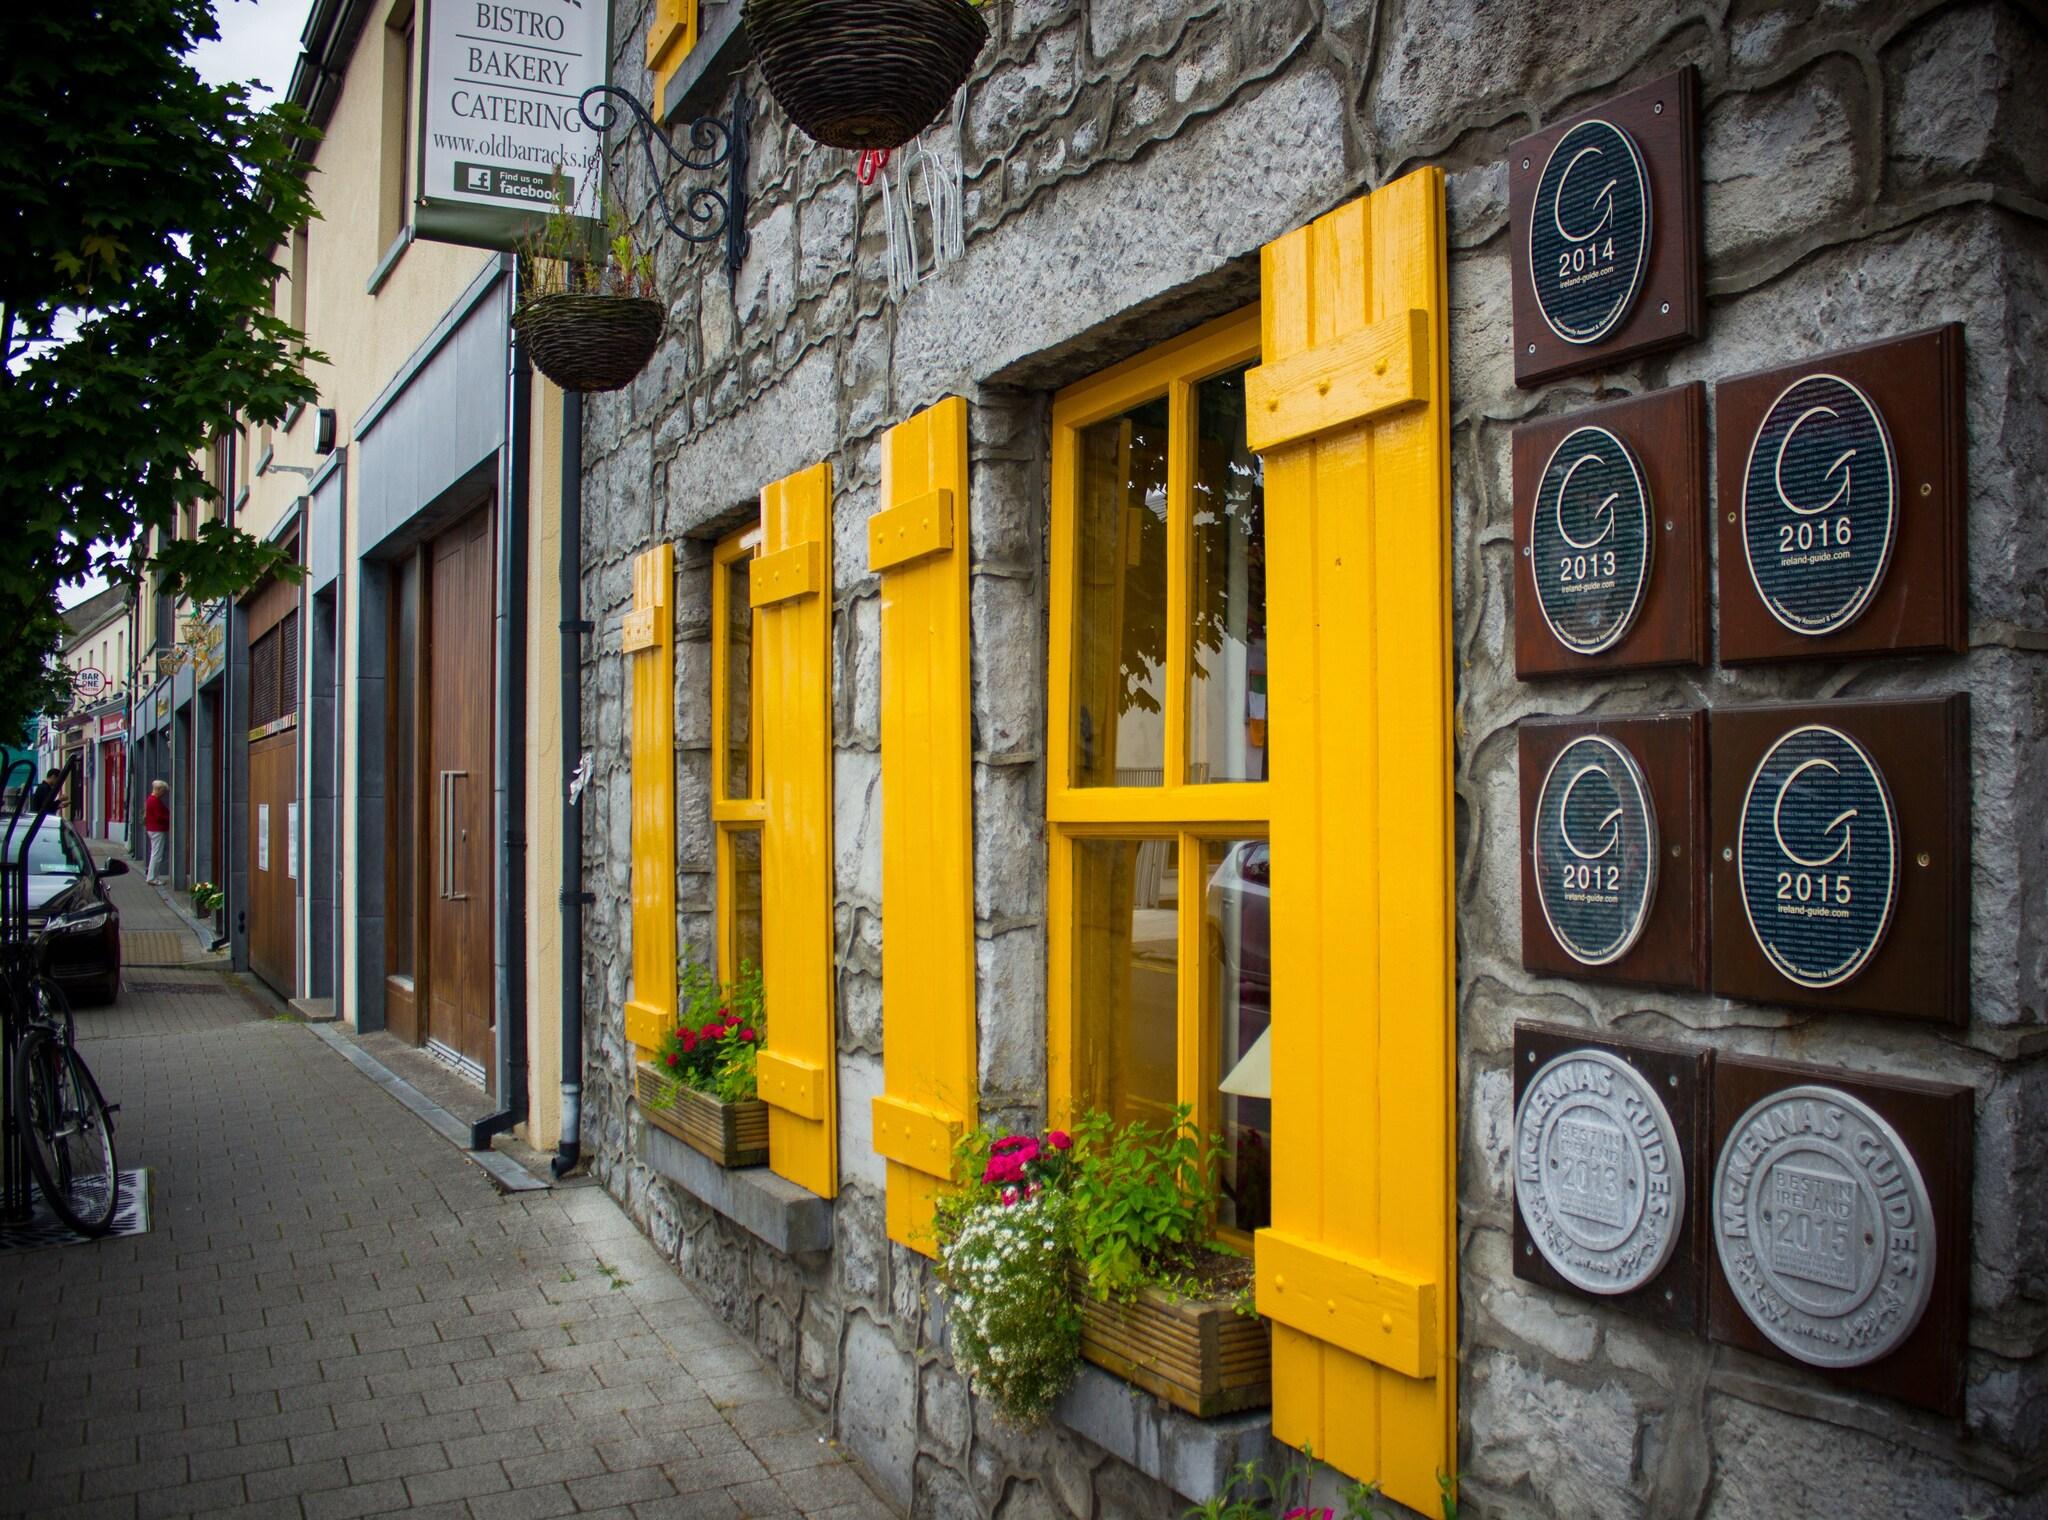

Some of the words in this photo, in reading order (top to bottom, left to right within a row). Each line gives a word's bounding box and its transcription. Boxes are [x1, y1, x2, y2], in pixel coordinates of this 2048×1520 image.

[477, 3, 565, 41] BISTRO
[469, 47, 569, 86] BAKERY
[451, 91, 582, 133] CATERING
[500, 171, 519, 181] Find
[520, 175, 531, 183] us
[532, 177, 544, 185] on
[1559, 237, 1615, 278] 2014
[1559, 265, 1614, 289] ireland-guide.com
[1779, 517, 1852, 552] 2016
[1560, 551, 1616, 581] 2013
[1780, 551, 1851, 567] ireland-guide.com
[1561, 580, 1616, 593] ireland-guide.com
[82, 680, 99, 688] ONE
[1563, 864, 1620, 891] 2012
[1777, 872, 1852, 905] 2015
[1564, 892, 1619, 904] ireland-guide.com
[1777, 903, 1850, 918] ireland-guide.com
[1624, 1095, 1672, 1219] GUIDES
[1776, 1172, 1825, 1195] BEST
[1831, 1182, 1852, 1203] IN
[1776, 1189, 1850, 1220] IRELAND
[1852, 1130, 1920, 1280] GUIDES
[1776, 1209, 1850, 1261] 2015
